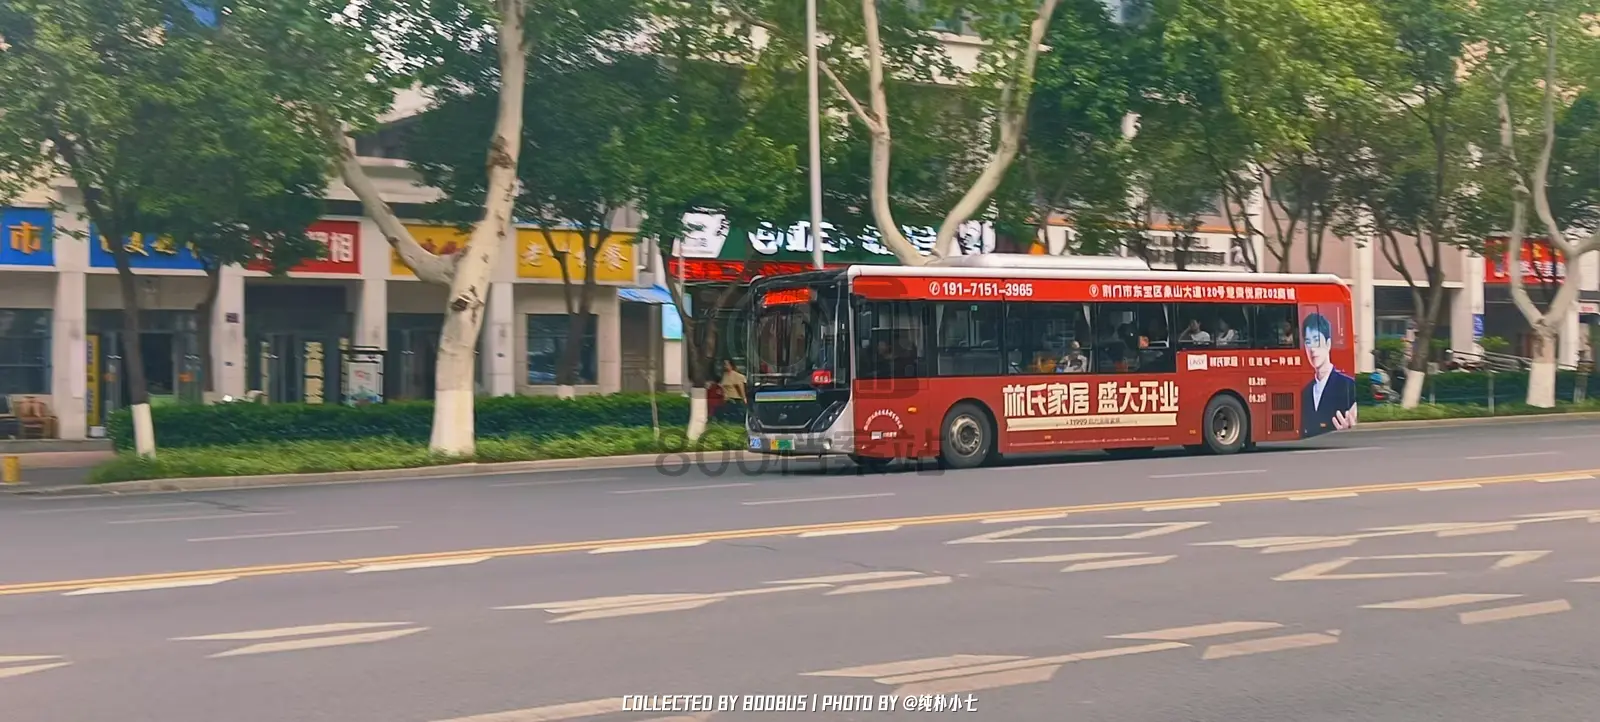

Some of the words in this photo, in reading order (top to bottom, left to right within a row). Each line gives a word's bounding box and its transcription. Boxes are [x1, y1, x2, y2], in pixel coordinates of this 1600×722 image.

[1003, 382, 1090, 417] 林氏家居
[1097, 380, 1179, 413] 盛大开业
